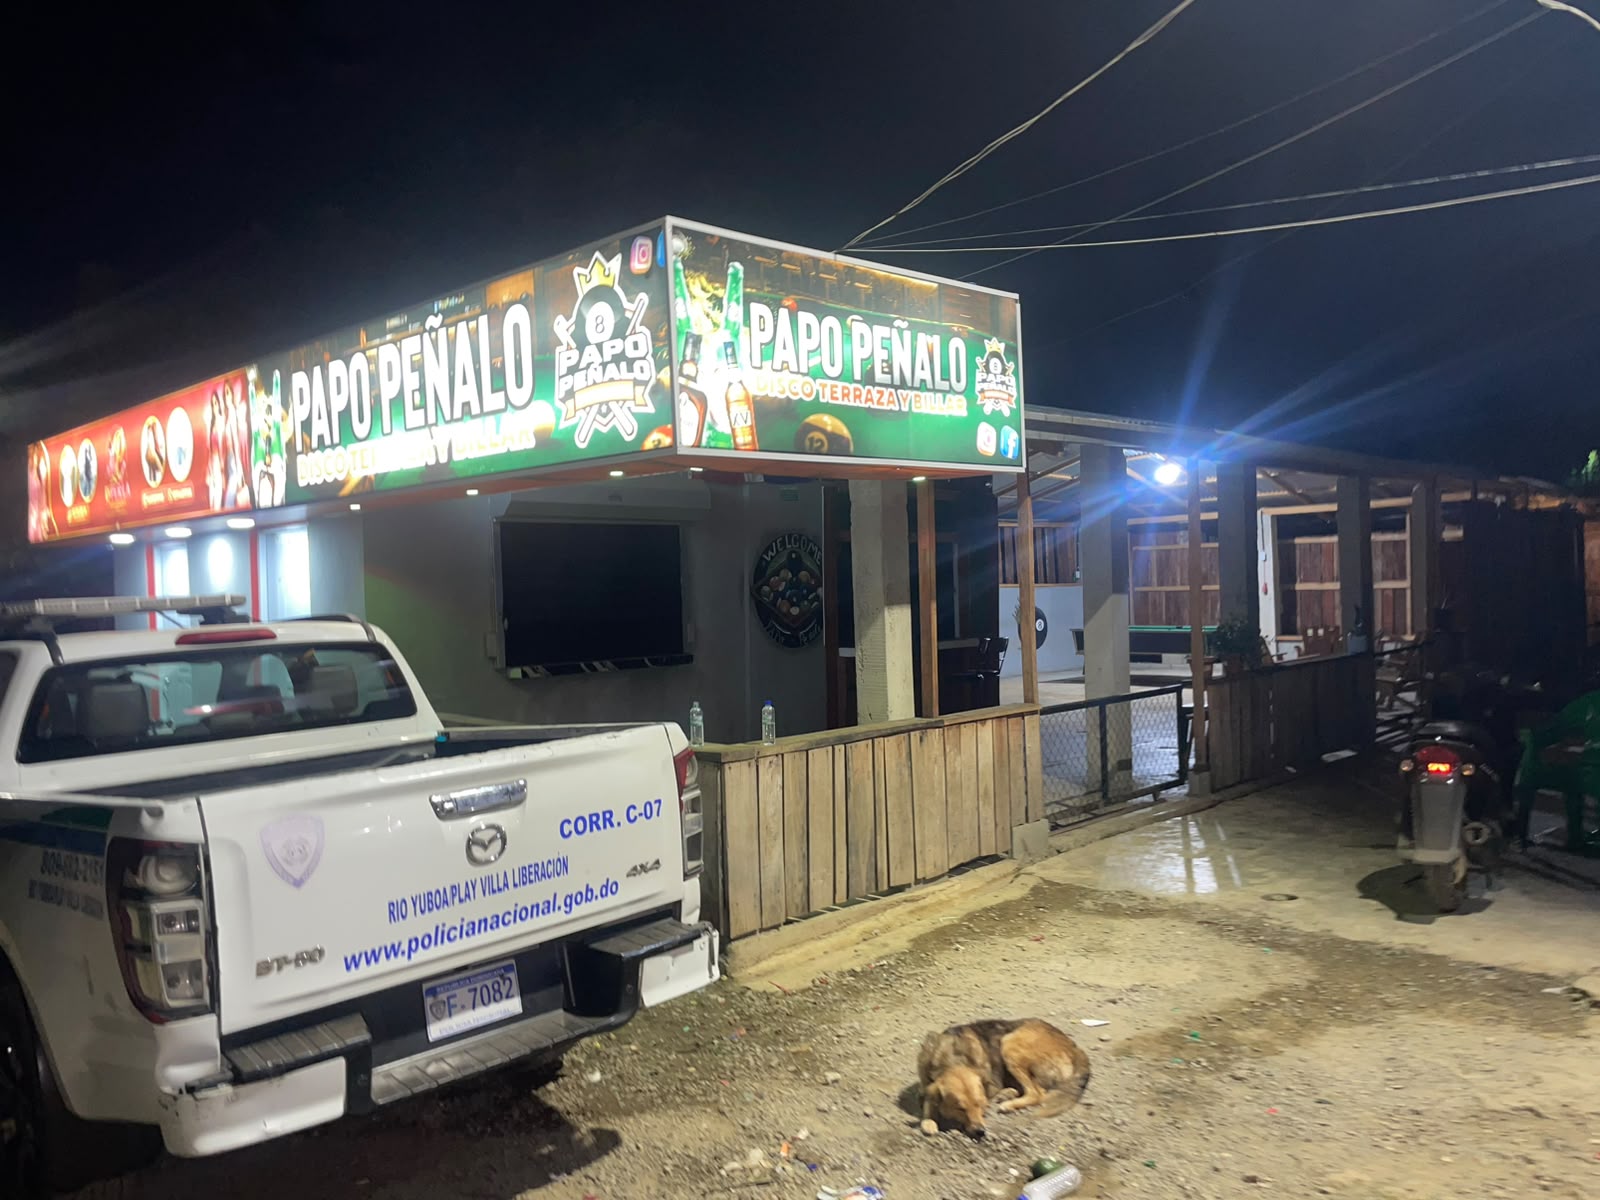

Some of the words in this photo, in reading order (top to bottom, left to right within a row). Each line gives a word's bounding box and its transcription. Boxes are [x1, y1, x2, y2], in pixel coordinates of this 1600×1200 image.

[559, 331, 649, 377] PAPO
[749, 302, 844, 378] PAPO
[851, 319, 967, 392] PEÑALO
[292, 351, 372, 453] PAPO
[378, 303, 533, 436] PEÑALO
[559, 358, 651, 399] PEÑALO
[756, 374, 814, 398] DISCO
[818, 382, 896, 406] TERRAZA
[898, 391, 909, 409] Y
[913, 394, 965, 411] BILLAR
[559, 809, 621, 839] CORR.
[625, 798, 662, 825] C-07
[388, 899, 408, 924] RIO
[480, 870, 510, 898] VILLA
[512, 852, 569, 889] LIBERACIÓN
[344, 877, 618, 973] www.policianacional.gob.do
